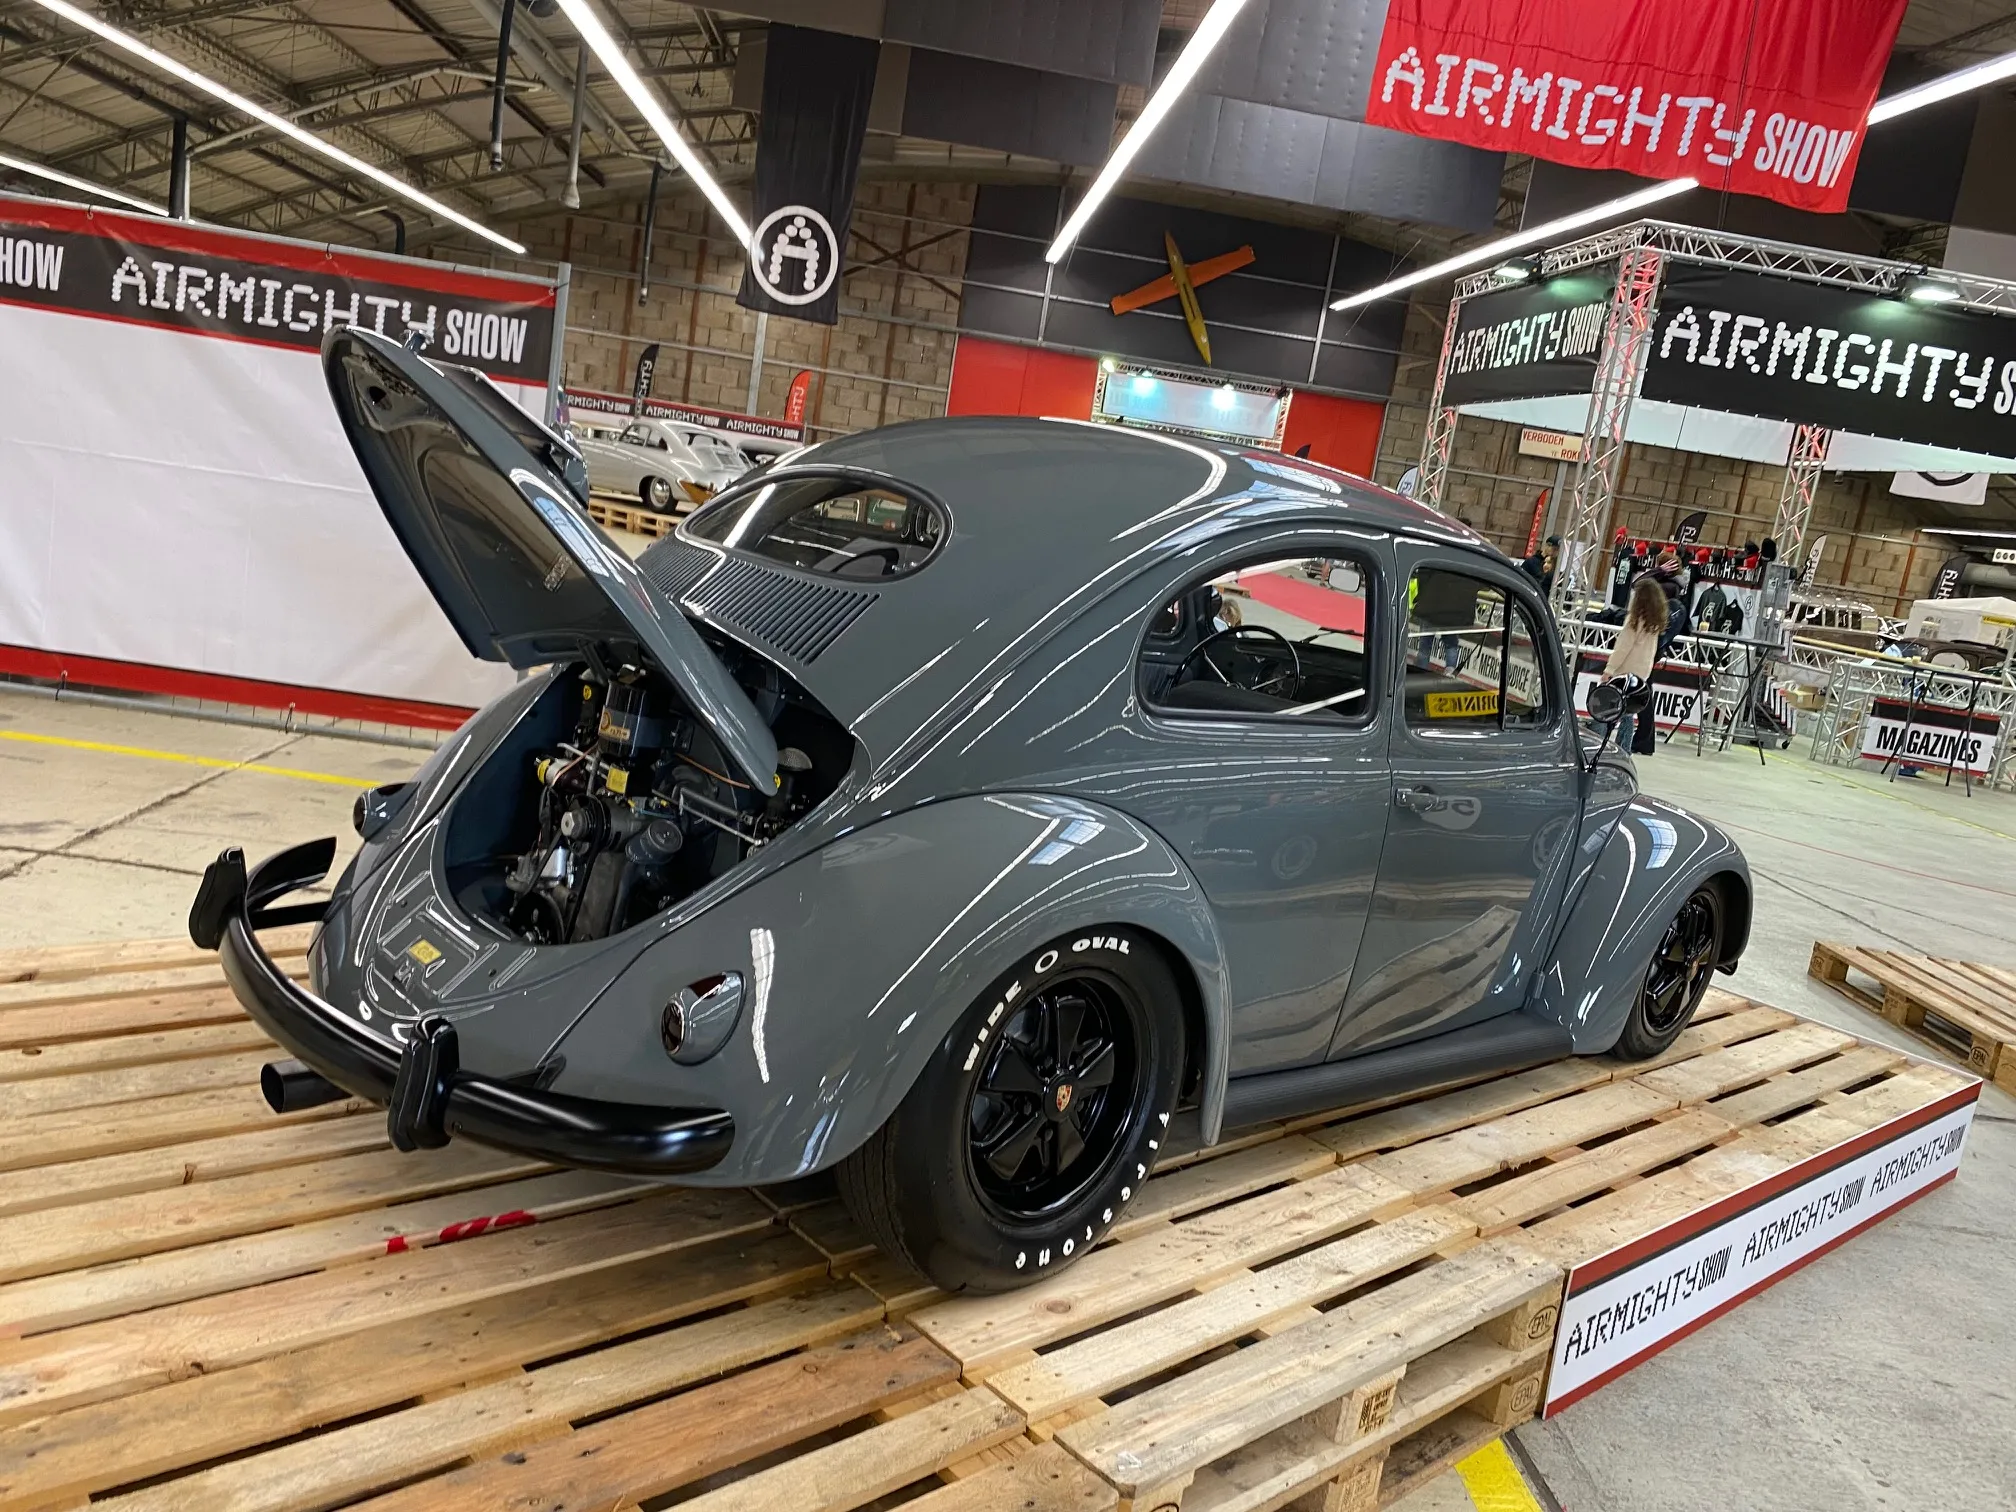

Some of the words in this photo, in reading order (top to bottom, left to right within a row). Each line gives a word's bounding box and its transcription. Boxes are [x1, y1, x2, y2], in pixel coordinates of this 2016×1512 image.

[1382, 46, 1756, 166] AIRMIGHTY
[1754, 112, 1858, 188] SHOW
[0, 235, 64, 291] HOW
[111, 256, 437, 351] AIRMIGHTY
[443, 309, 528, 363] SHOW
[1450, 309, 1568, 375] AIRMIGHTY
[1561, 302, 1607, 358] SHOW
[1660, 306, 1994, 408] AIRMIGHTY
[1994, 361, 2016, 415] S
[567, 394, 614, 411] RMIGHTY
[646, 405, 703, 426] AIRMIGHTY
[726, 420, 783, 438] AIRMIGHTY
[1523, 431, 1564, 446] VERBODEN
[1876, 725, 1982, 764] MAGAZINES
[963, 979, 1023, 1071] WIDE
[1072, 935, 1130, 955] OVAL
[1564, 1260, 1700, 1365] AIRMIGHTY
[1699, 1245, 1733, 1291] SHOW
[1742, 1193, 1840, 1267] AIRMIGHTY
[1838, 1176, 1867, 1215] SHOW
[1870, 1136, 1948, 1198] AIRMIGHTY
[1943, 1123, 1967, 1156] SHOW
